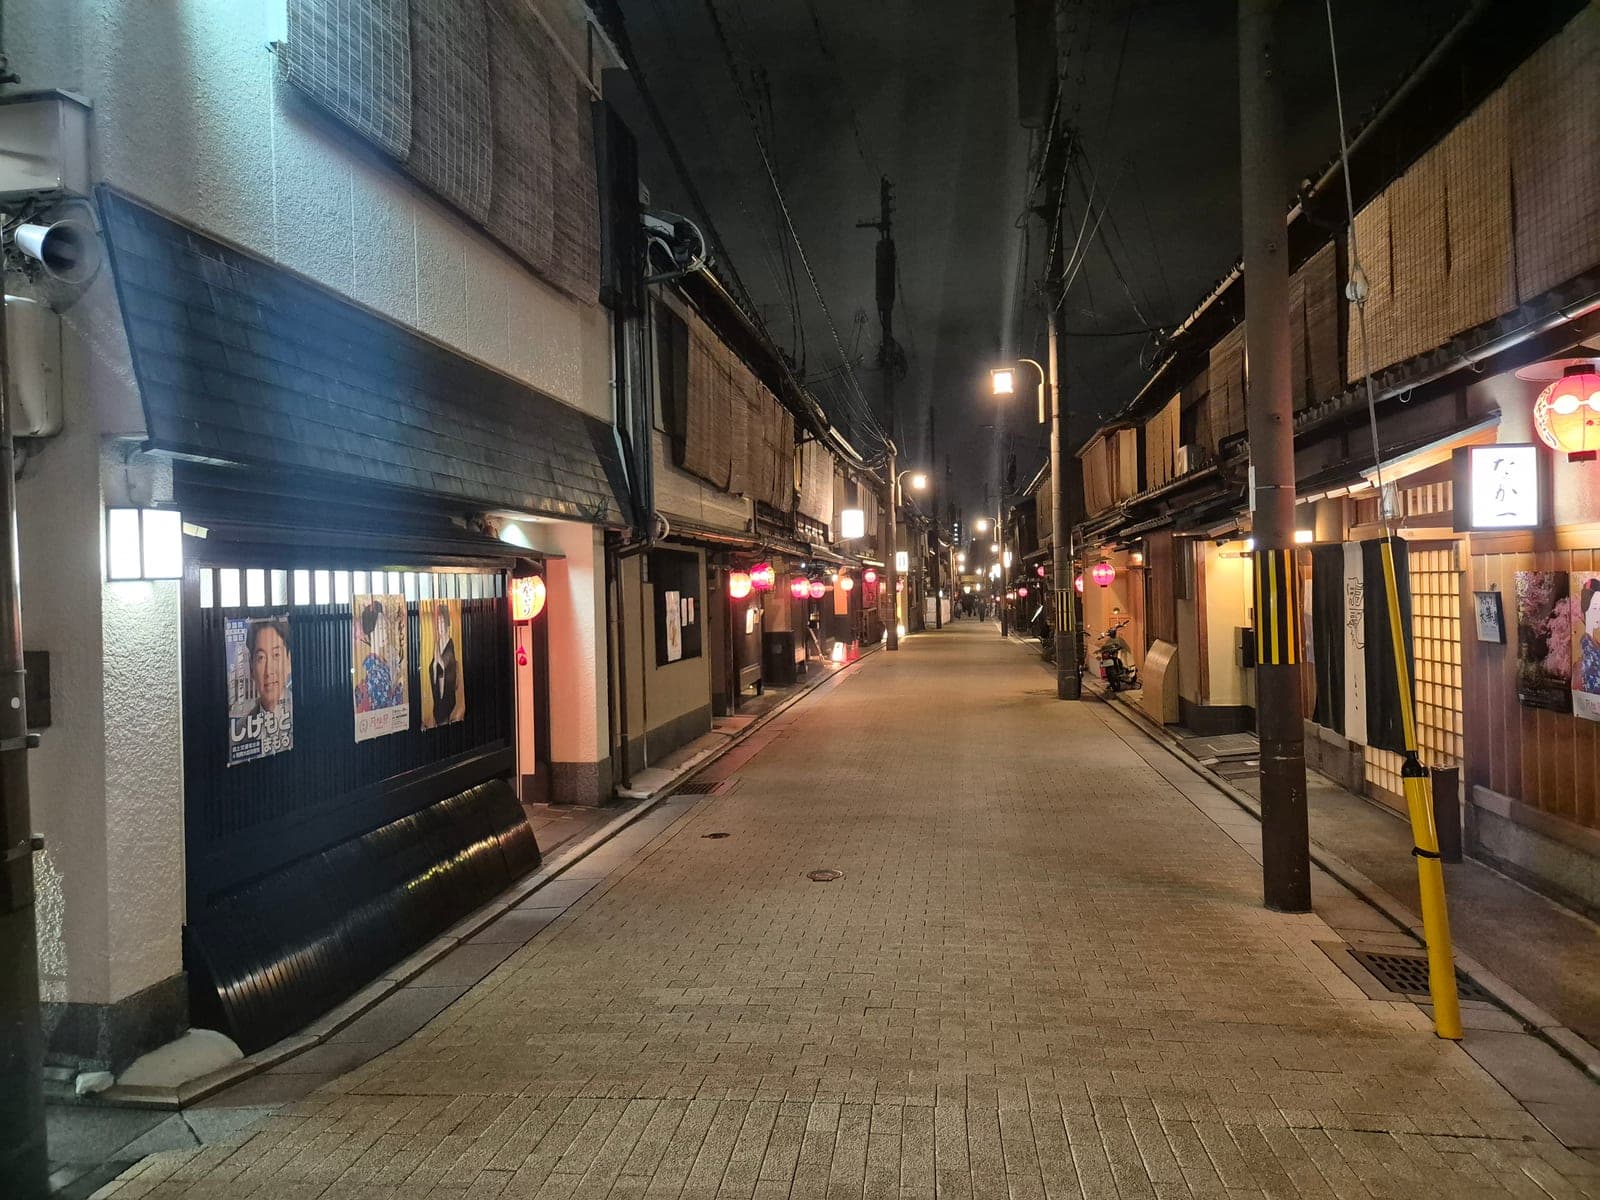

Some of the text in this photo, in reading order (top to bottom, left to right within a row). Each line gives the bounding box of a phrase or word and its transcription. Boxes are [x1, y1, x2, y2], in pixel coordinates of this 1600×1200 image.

[1492, 457, 1518, 516] なか一
[231, 708, 291, 742] しげもと
[263, 732, 290, 753] まもる
